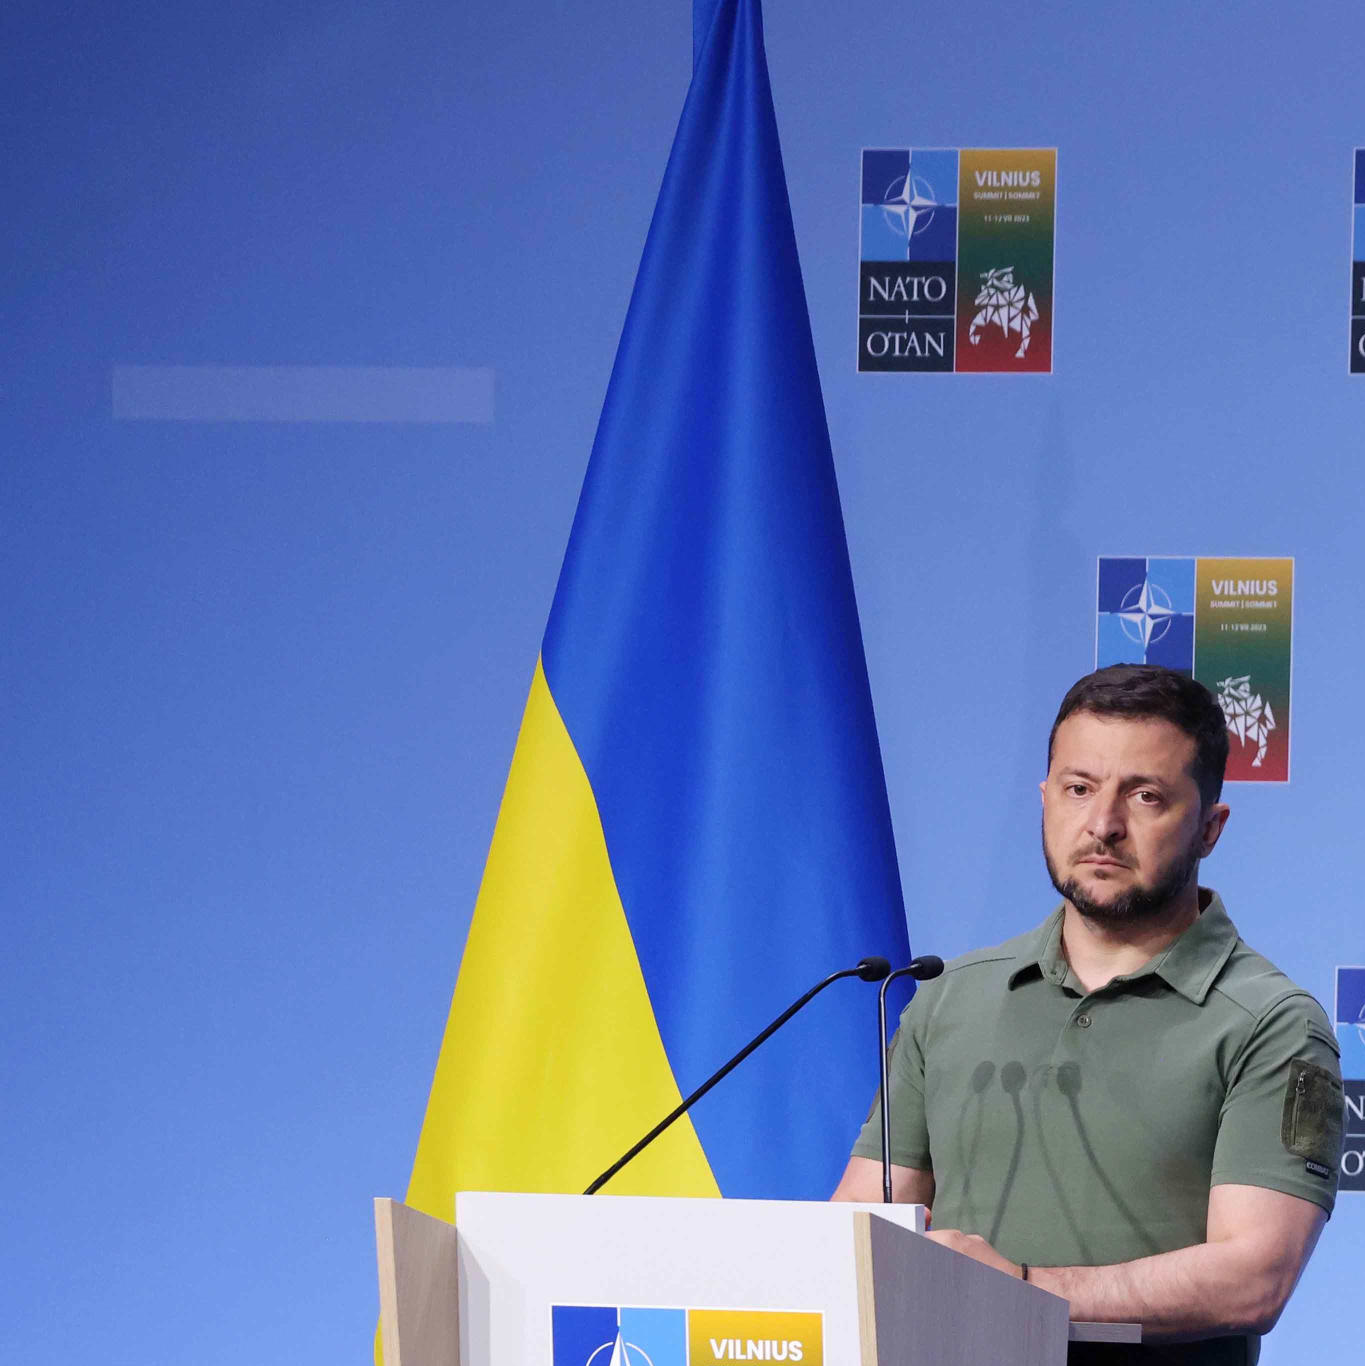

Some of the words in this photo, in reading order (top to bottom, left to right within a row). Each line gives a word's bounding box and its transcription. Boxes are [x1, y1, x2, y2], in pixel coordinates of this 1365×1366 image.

[975, 170, 1040, 187] VILNIUS
[870, 277, 946, 301] NATO
[867, 332, 944, 356] OTAN
[1211, 579, 1278, 596] VILNIUS
[709, 1338, 803, 1361] VILNIUS
